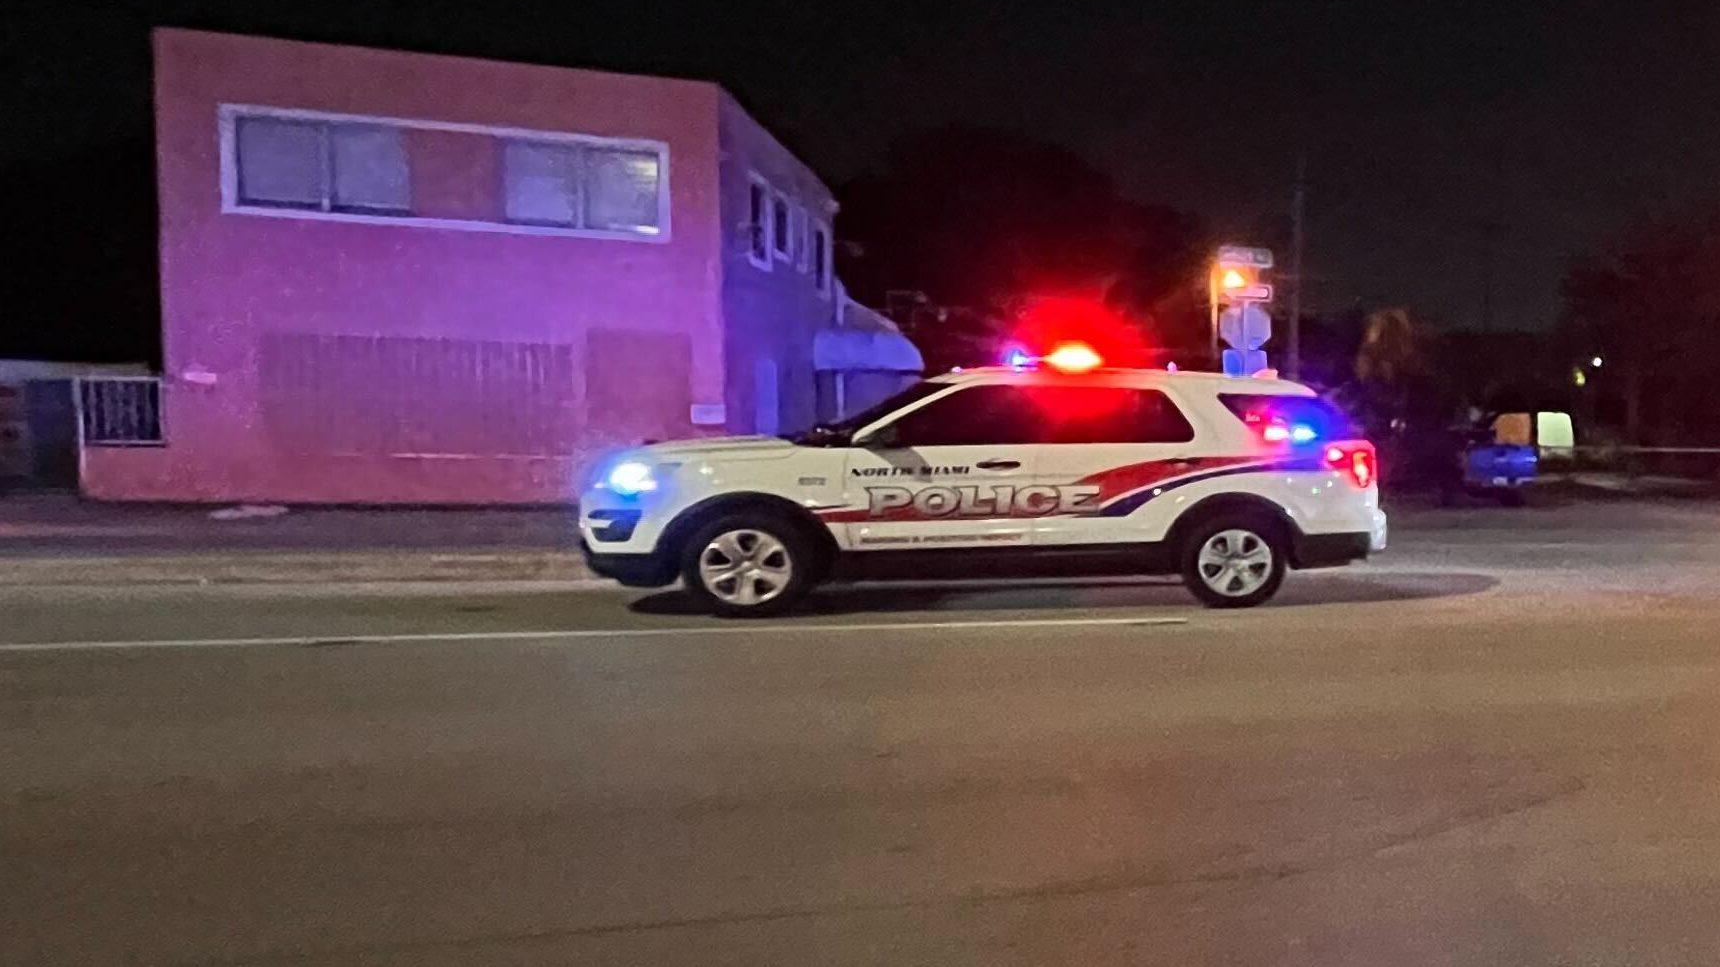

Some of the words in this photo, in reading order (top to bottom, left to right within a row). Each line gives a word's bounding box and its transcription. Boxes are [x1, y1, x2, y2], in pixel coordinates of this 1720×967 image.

[851, 467, 913, 477] NORTH
[920, 466, 971, 476] MIAMI
[864, 484, 1101, 518] POLICE
